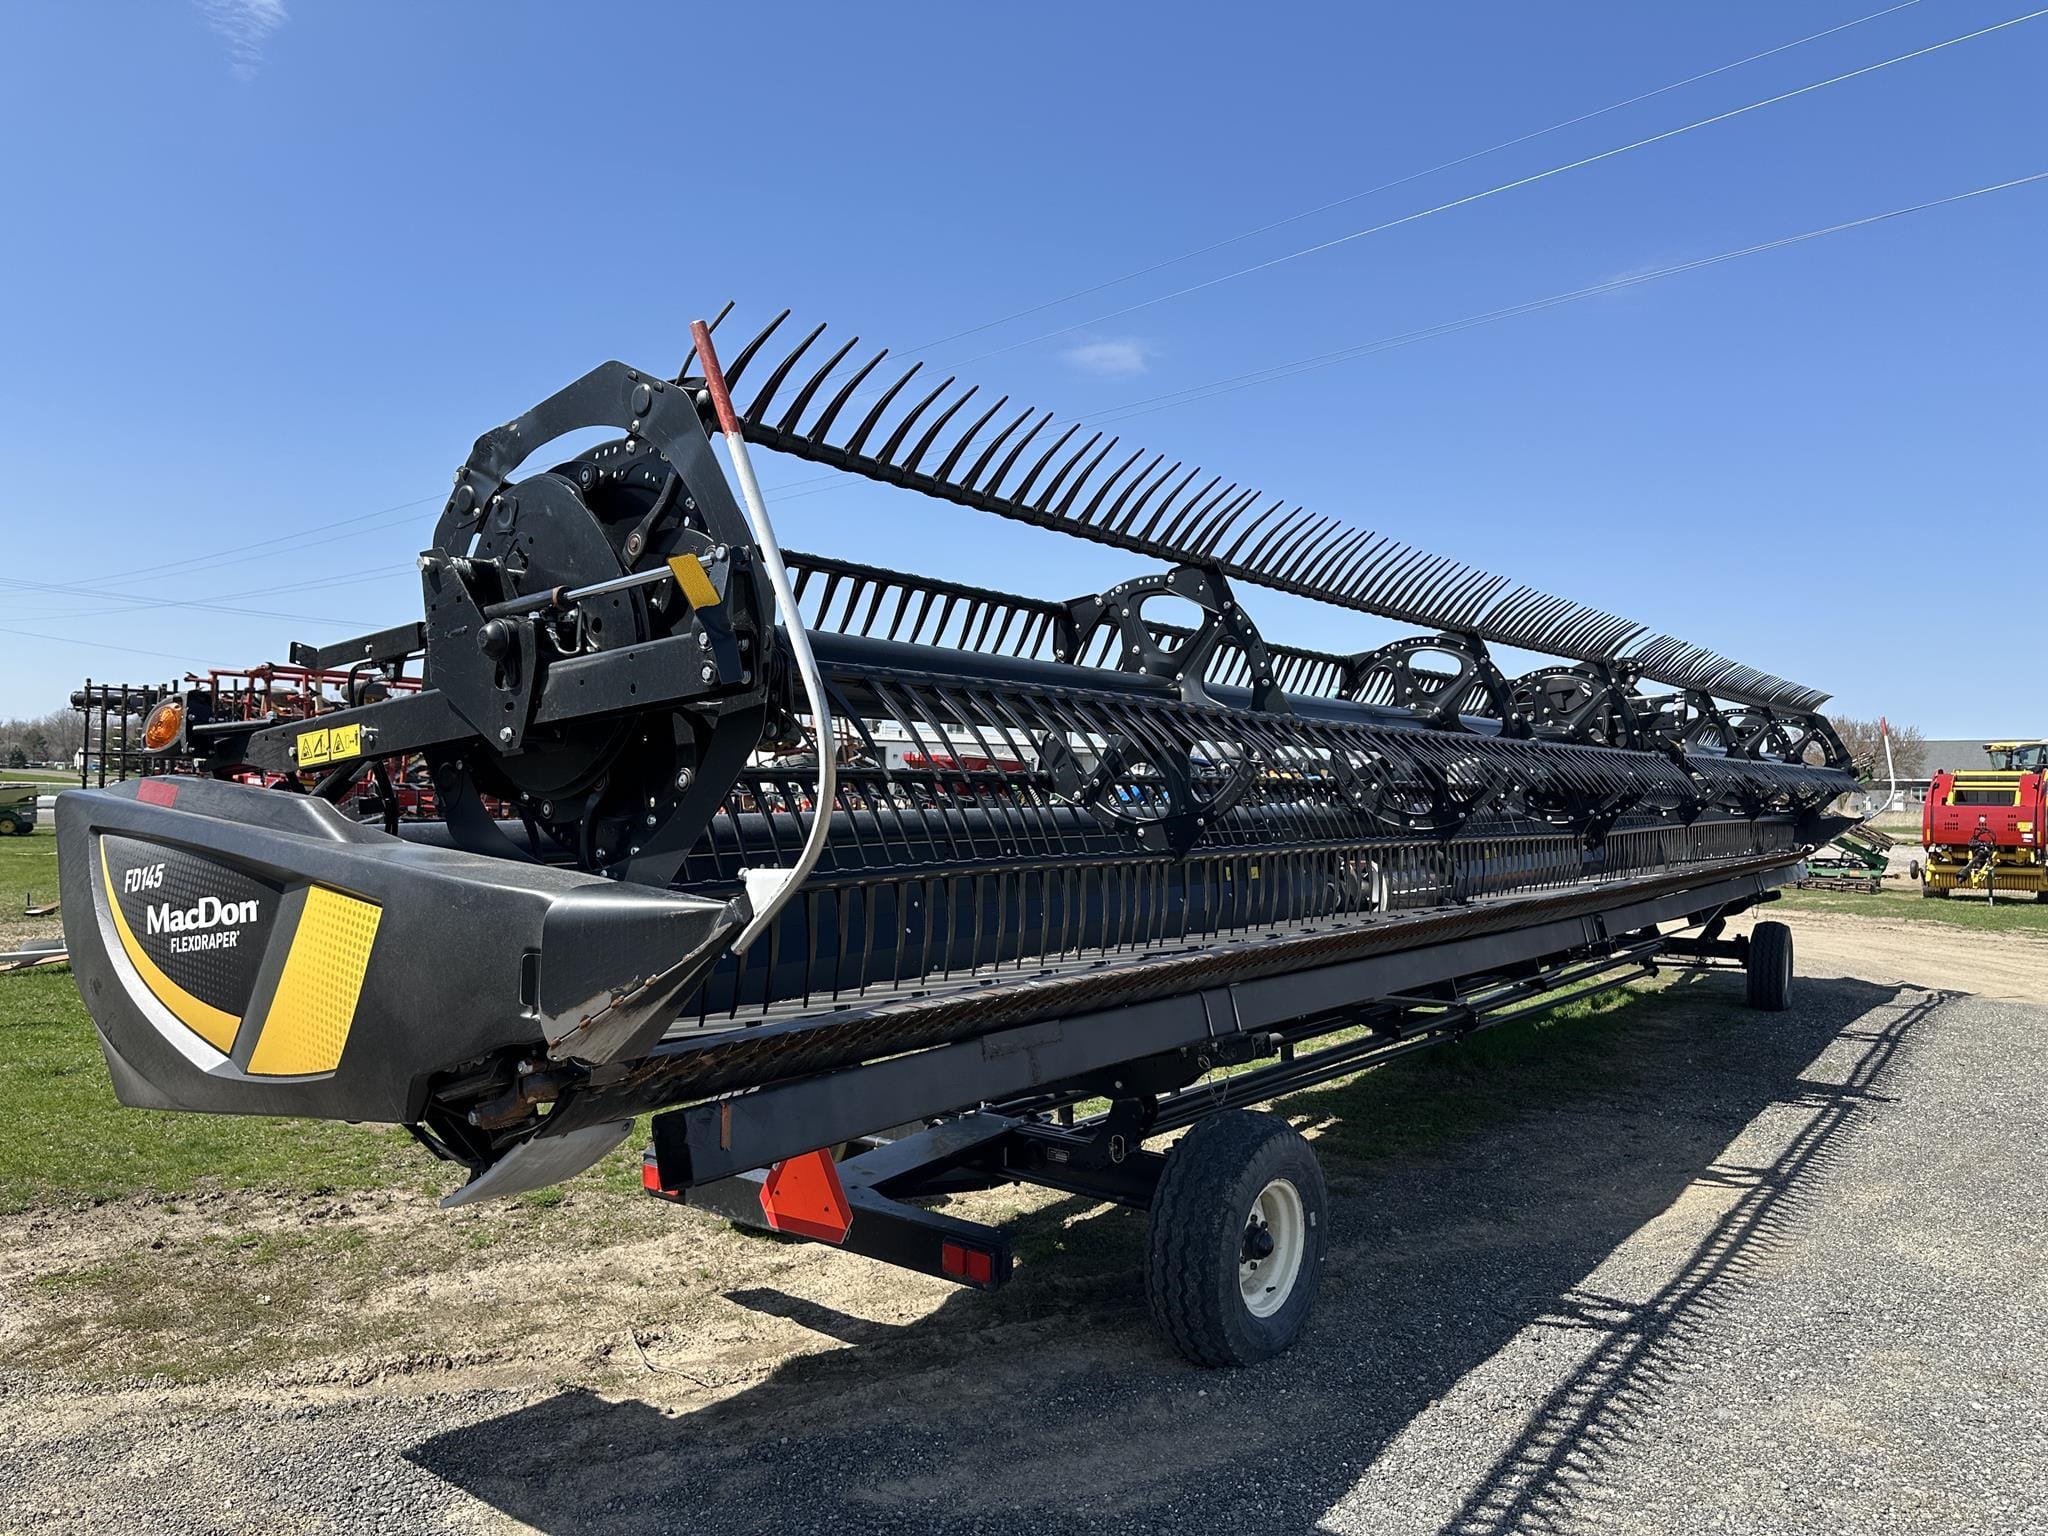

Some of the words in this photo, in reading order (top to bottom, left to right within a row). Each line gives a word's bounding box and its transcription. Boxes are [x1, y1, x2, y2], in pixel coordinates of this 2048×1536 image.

[124, 863, 165, 894] FD145
[147, 896, 258, 935] MacDon
[170, 931, 238, 954] FLEXDRAPER
